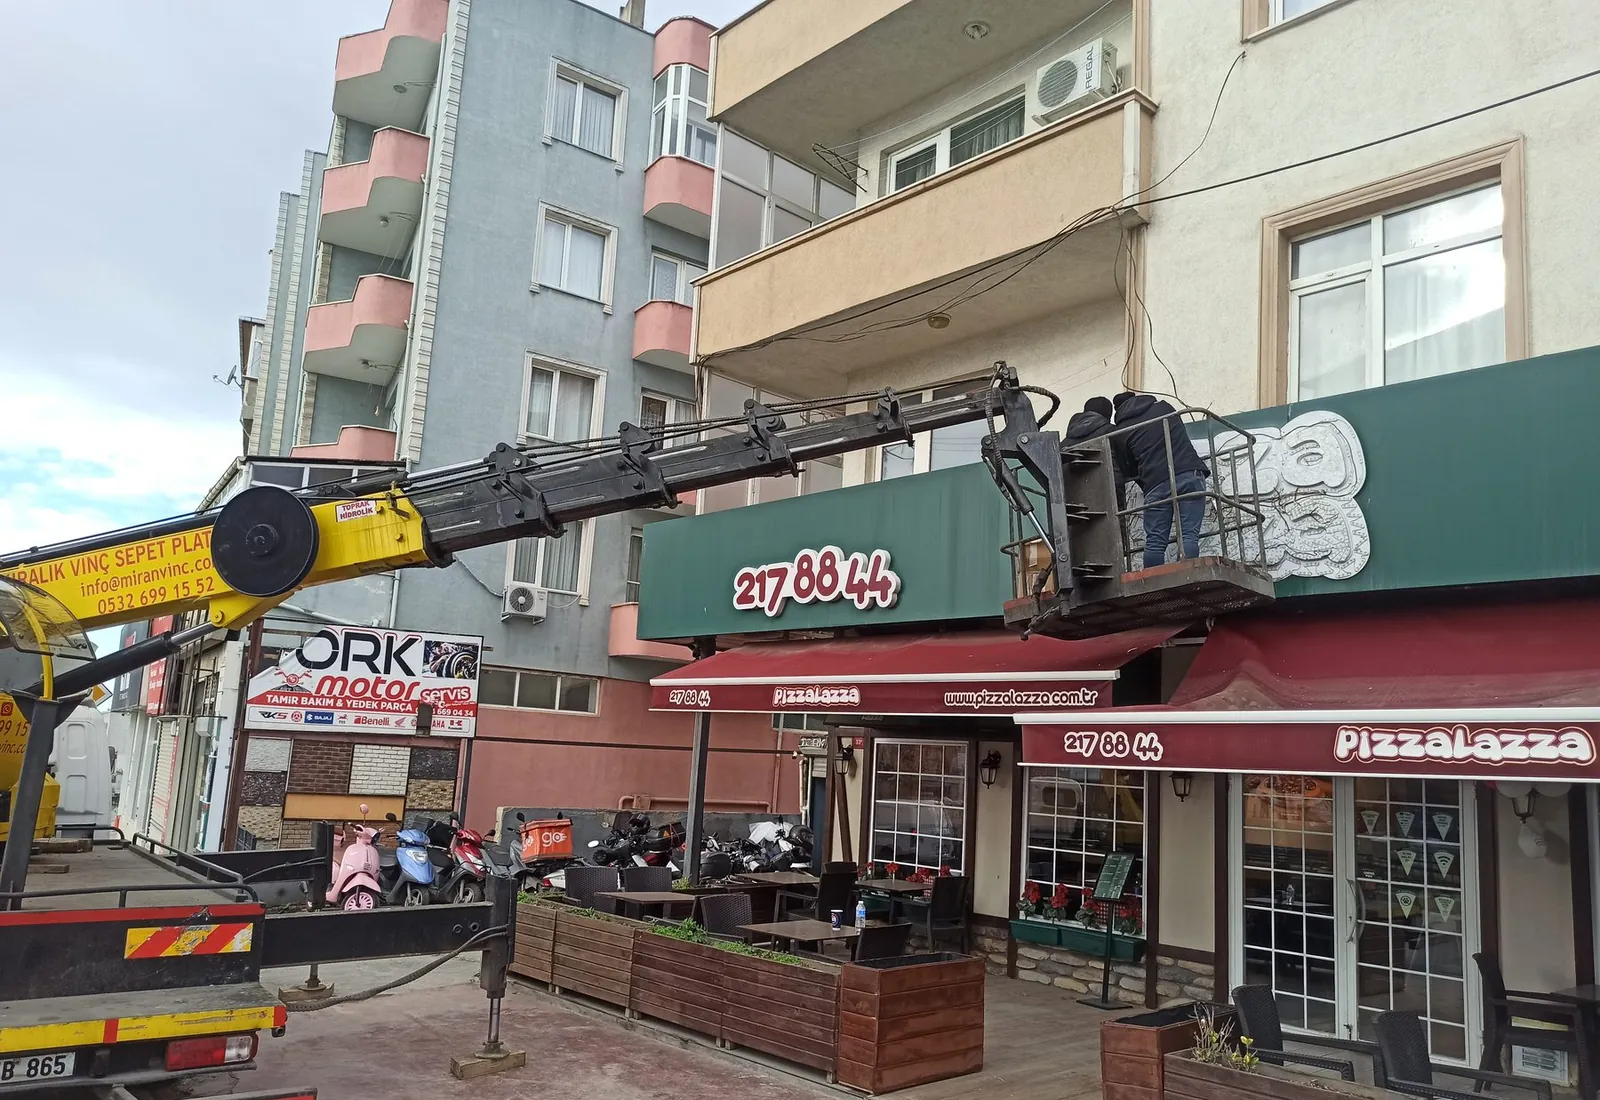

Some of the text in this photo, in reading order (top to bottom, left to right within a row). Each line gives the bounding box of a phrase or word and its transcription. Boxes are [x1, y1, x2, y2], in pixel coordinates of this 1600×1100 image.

[1085, 45, 1094, 90] REGAL
[6, 562, 66, 585] RALIK
[70, 553, 110, 577] VINÇ
[115, 541, 166, 567] SEPET
[80, 557, 216, 598] info@miranvinc.co
[736, 550, 893, 613] 217 88 44
[98, 576, 215, 615] 0532 699 15 52
[296, 629, 418, 677] ORK
[314, 675, 420, 701] motor
[420, 687, 471, 704] servis
[669, 690, 711, 707] 217 88 44
[300, 697, 334, 708] BAKIM
[336, 699, 344, 708] &
[346, 700, 378, 711] YEDEK
[380, 702, 413, 714] PARÇA
[452, 709, 463, 717] 04
[361, 716, 390, 726] Benelli
[432, 720, 445, 728] AHA
[1064, 731, 1164, 761] 217 88 44
[1, 1054, 67, 1080] B 865
